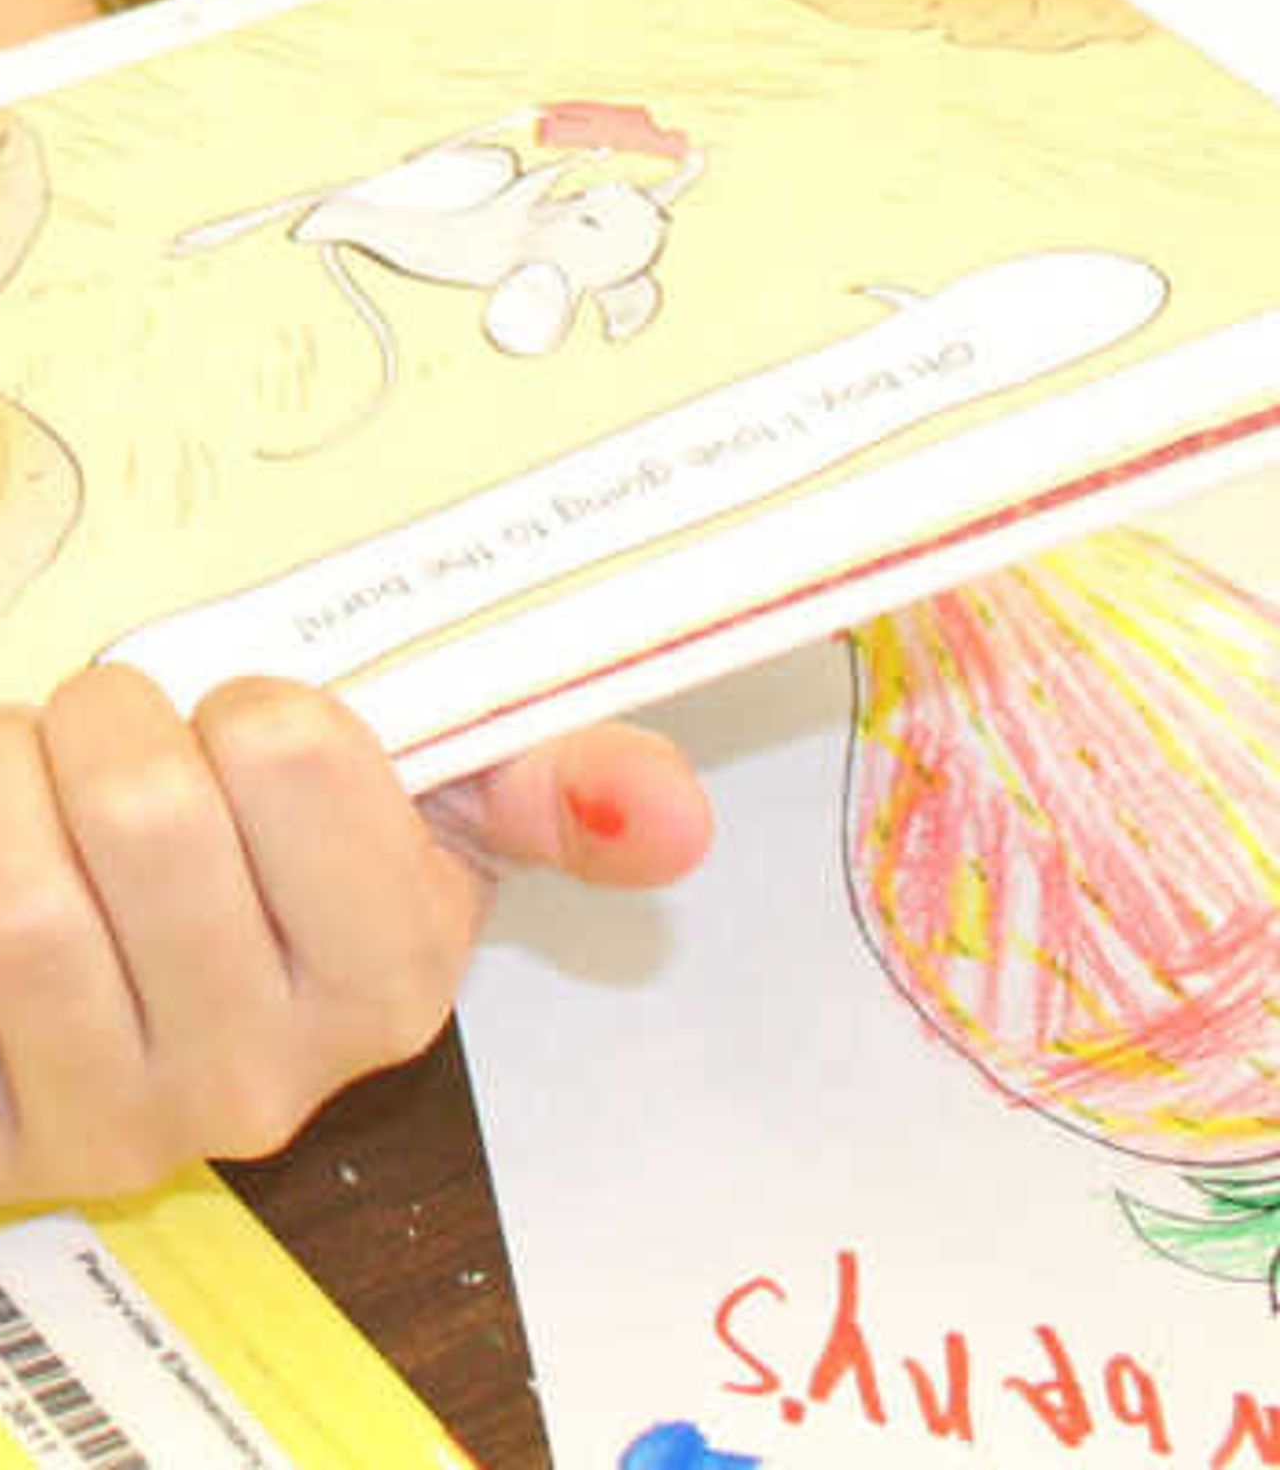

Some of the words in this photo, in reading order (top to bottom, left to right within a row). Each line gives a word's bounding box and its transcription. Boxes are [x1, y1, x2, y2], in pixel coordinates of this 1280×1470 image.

[907, 338, 975, 382] Oh
[684, 420, 778, 469] love
[550, 458, 674, 525] going
[501, 516, 550, 548] to
[418, 538, 496, 580] the
[288, 573, 414, 646] barn!
